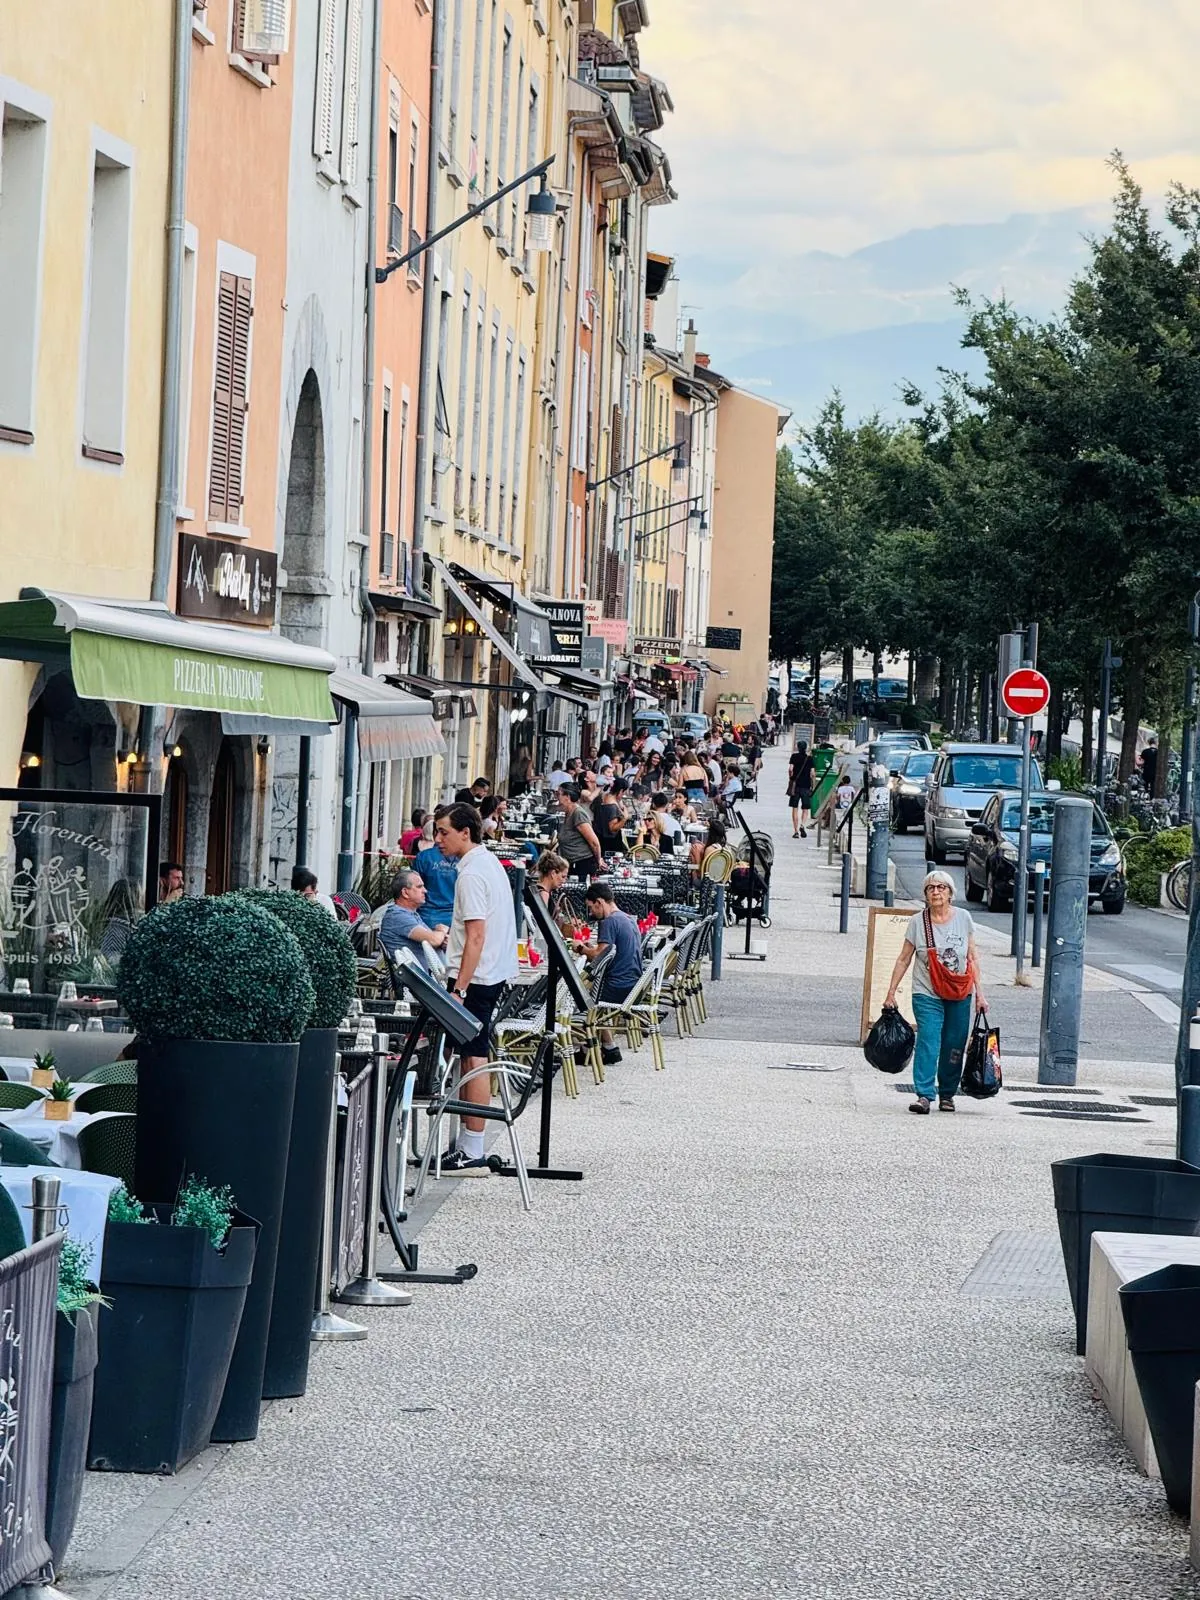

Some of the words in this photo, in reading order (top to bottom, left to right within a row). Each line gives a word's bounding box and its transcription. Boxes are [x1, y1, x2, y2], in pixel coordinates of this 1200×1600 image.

[542, 608, 581, 621] SANOVA
[555, 633, 580, 644] ERIA
[634, 640, 680, 650] PIZZERIA
[641, 647, 673, 656] GRILL
[174, 658, 216, 695] PIZZERIA
[216, 664, 265, 701] TRADIZIONE
[2, 952, 39, 969] epuis
[49, 953, 82, 967] 1989
